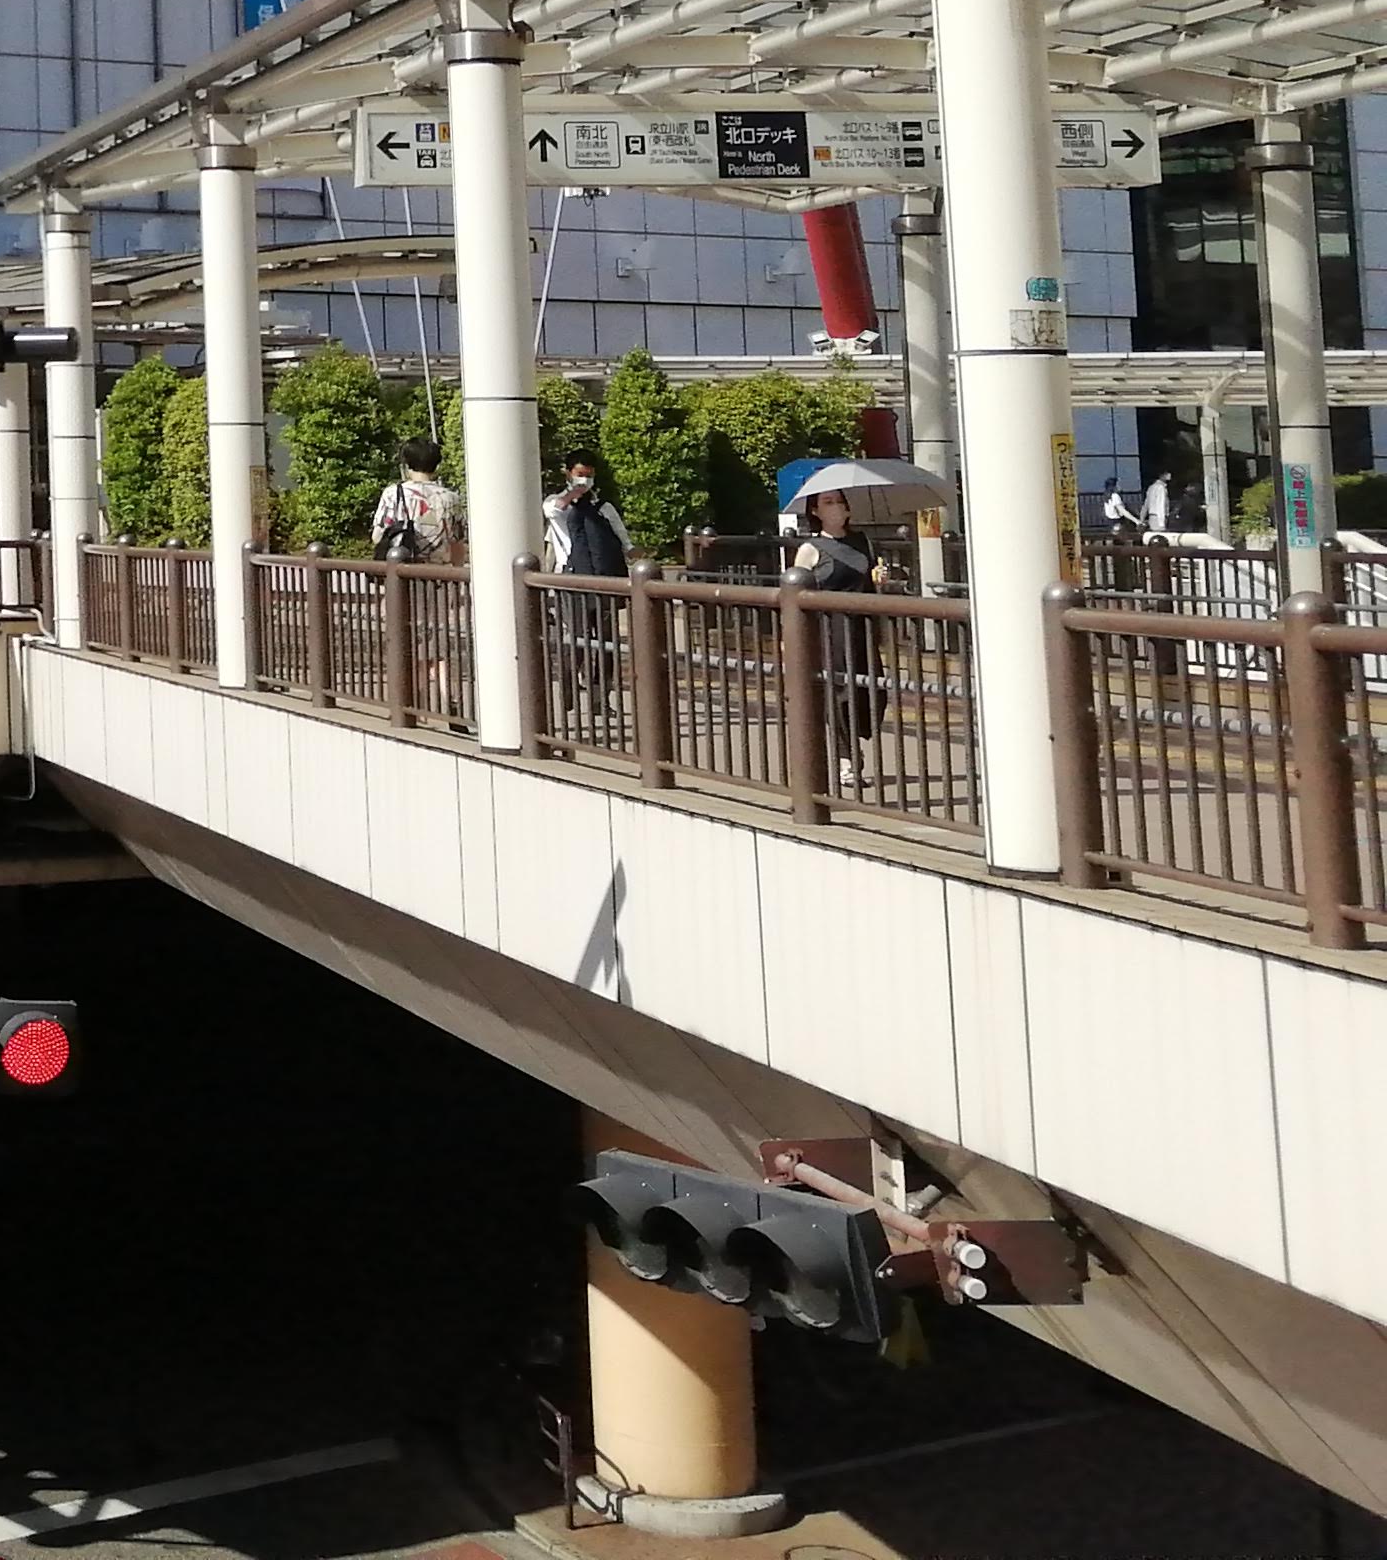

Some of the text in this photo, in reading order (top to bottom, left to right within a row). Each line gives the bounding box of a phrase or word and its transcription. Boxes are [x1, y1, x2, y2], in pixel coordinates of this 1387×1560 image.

[576, 124, 608, 141] 南北
[725, 126, 798, 145] 北口デッキ
[1060, 123, 1094, 139] 西側
[748, 150, 775, 163] North
[728, 163, 801, 176] Pedestrian Deck
